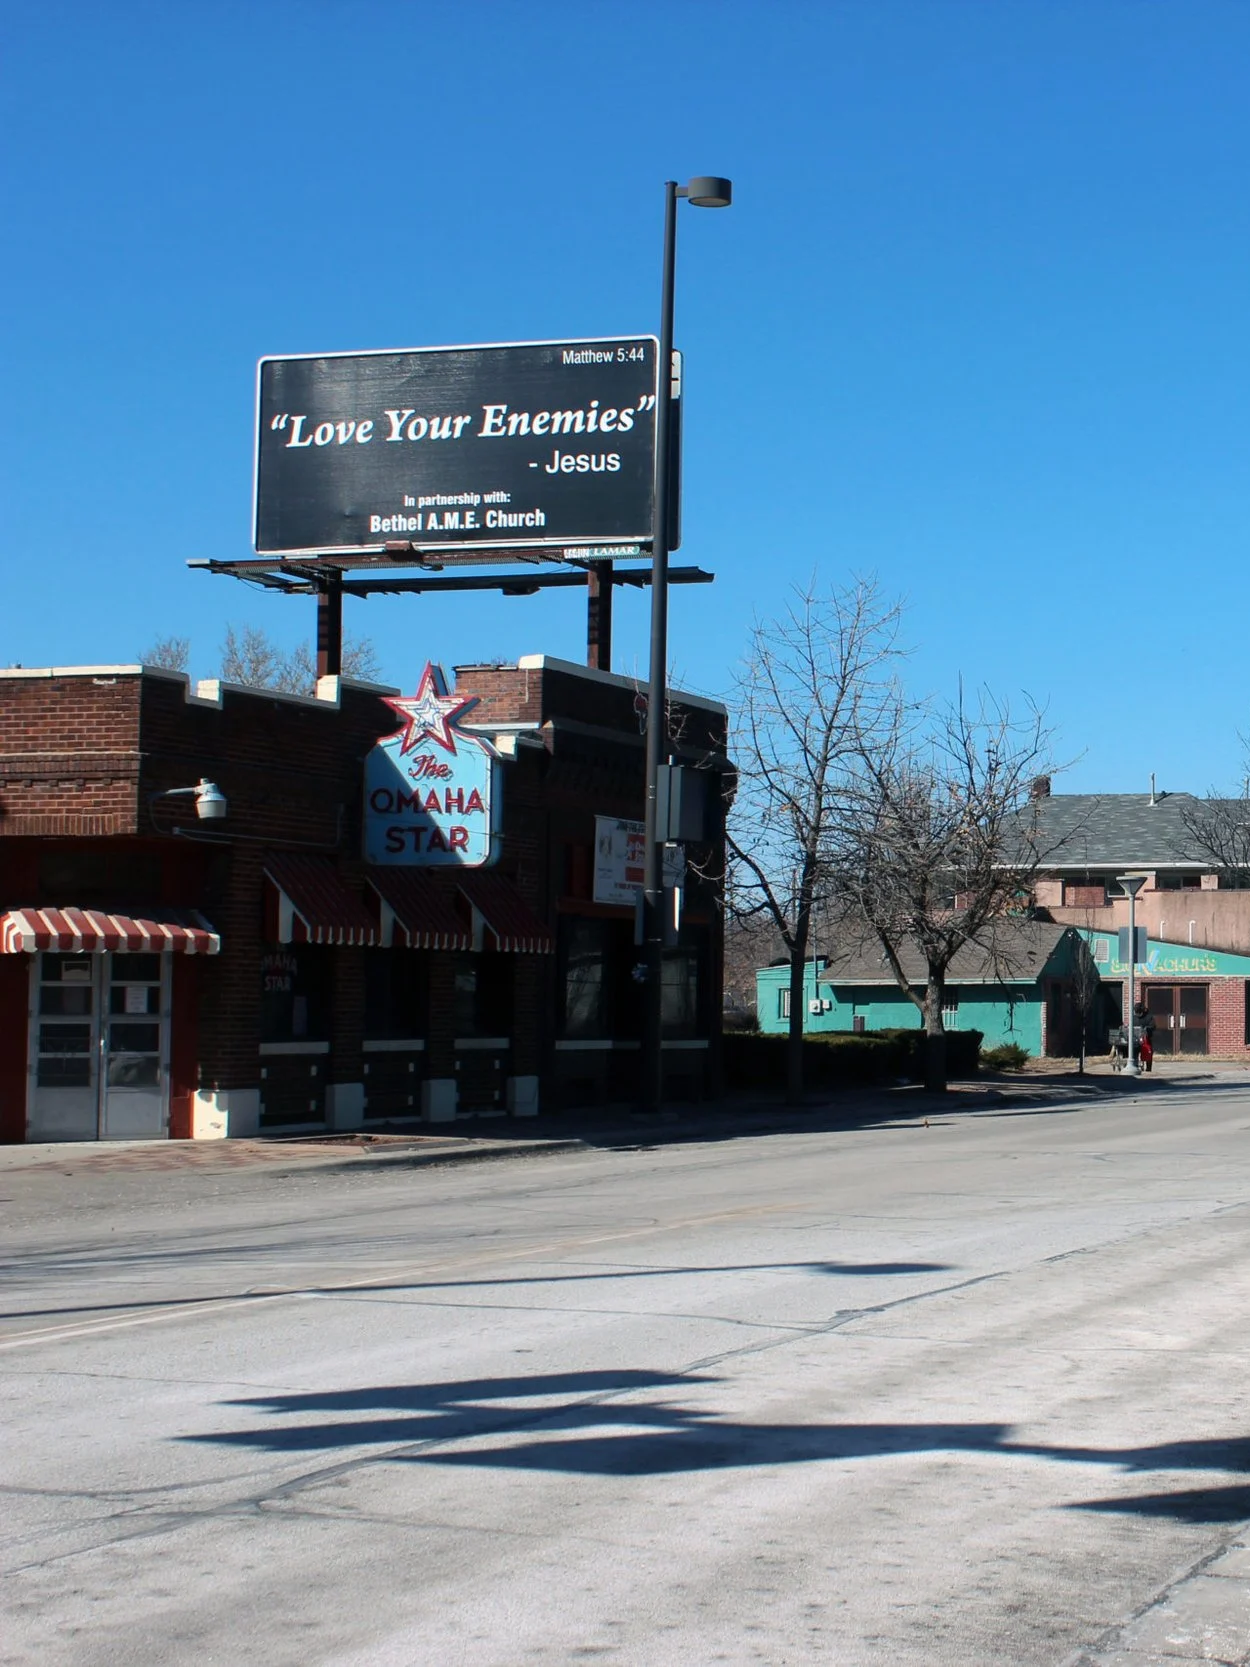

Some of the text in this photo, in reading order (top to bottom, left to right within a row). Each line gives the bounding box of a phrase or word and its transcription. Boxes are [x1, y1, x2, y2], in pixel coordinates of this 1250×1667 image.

[562, 347, 645, 365] Matthew 5:44
[270, 394, 657, 448] “Love Your Enemies”
[545, 450, 621, 474] Jesus
[404, 490, 511, 509] In partnership with:
[370, 508, 546, 533] Bethel A.M.E. Church
[593, 544, 637, 555] LAMAR
[408, 754, 453, 780] The
[370, 787, 485, 815] OMAHA
[385, 826, 470, 853] STAR
[263, 975, 292, 992] STAR
